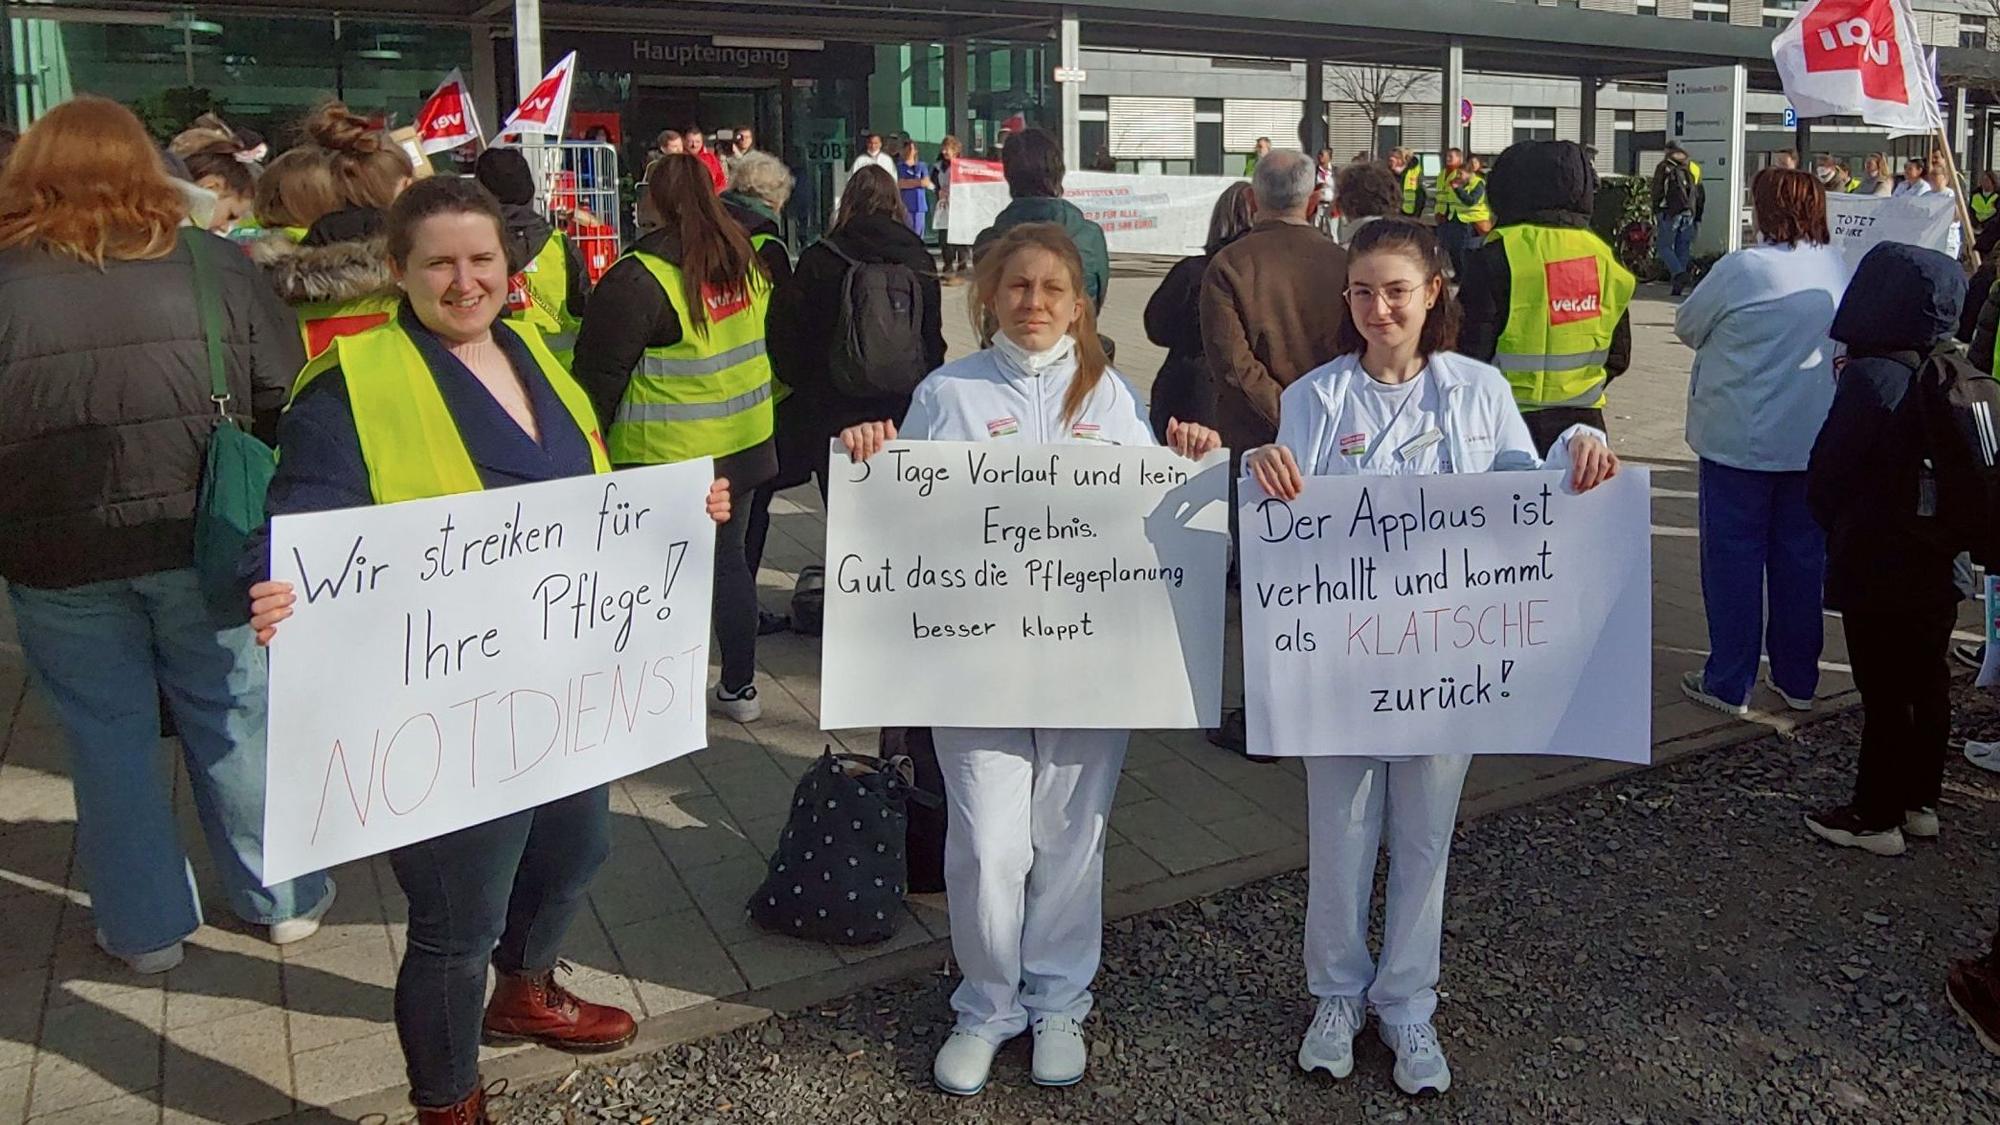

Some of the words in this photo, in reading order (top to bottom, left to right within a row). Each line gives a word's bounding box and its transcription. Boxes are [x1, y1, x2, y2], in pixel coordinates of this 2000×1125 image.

[633, 39, 790, 69] Haupteingang
[808, 142, 842, 160] 20B
[1551, 294, 1597, 312] ver.di
[888, 449, 950, 497] Tage
[967, 450, 1059, 486] Vorlauf
[1074, 463, 1121, 486] und
[1140, 459, 1187, 486] kein
[293, 536, 390, 603] Wir
[420, 502, 563, 581] streiken
[597, 482, 651, 551] für
[983, 505, 1098, 553] Ergebnis.
[1257, 498, 1331, 542] Der
[1349, 487, 1486, 552] Applaus
[1512, 483, 1554, 526] ist
[838, 554, 895, 593] Gut
[906, 555, 966, 588] dass
[974, 560, 1009, 587] die
[1025, 558, 1185, 593] Pflegeplanung
[1257, 557, 1378, 608] verhallt
[1395, 549, 1448, 597] und
[1464, 541, 1554, 588] kommt
[404, 608, 501, 686] Ihre
[532, 541, 688, 652] Pflege!
[913, 612, 997, 639] besser
[1022, 612, 1094, 640] klappt
[1275, 618, 1317, 652] als
[1346, 600, 1549, 656] KLATSCHE
[1369, 660, 1515, 712] zurück!
[311, 645, 702, 845] NOTDIENST
